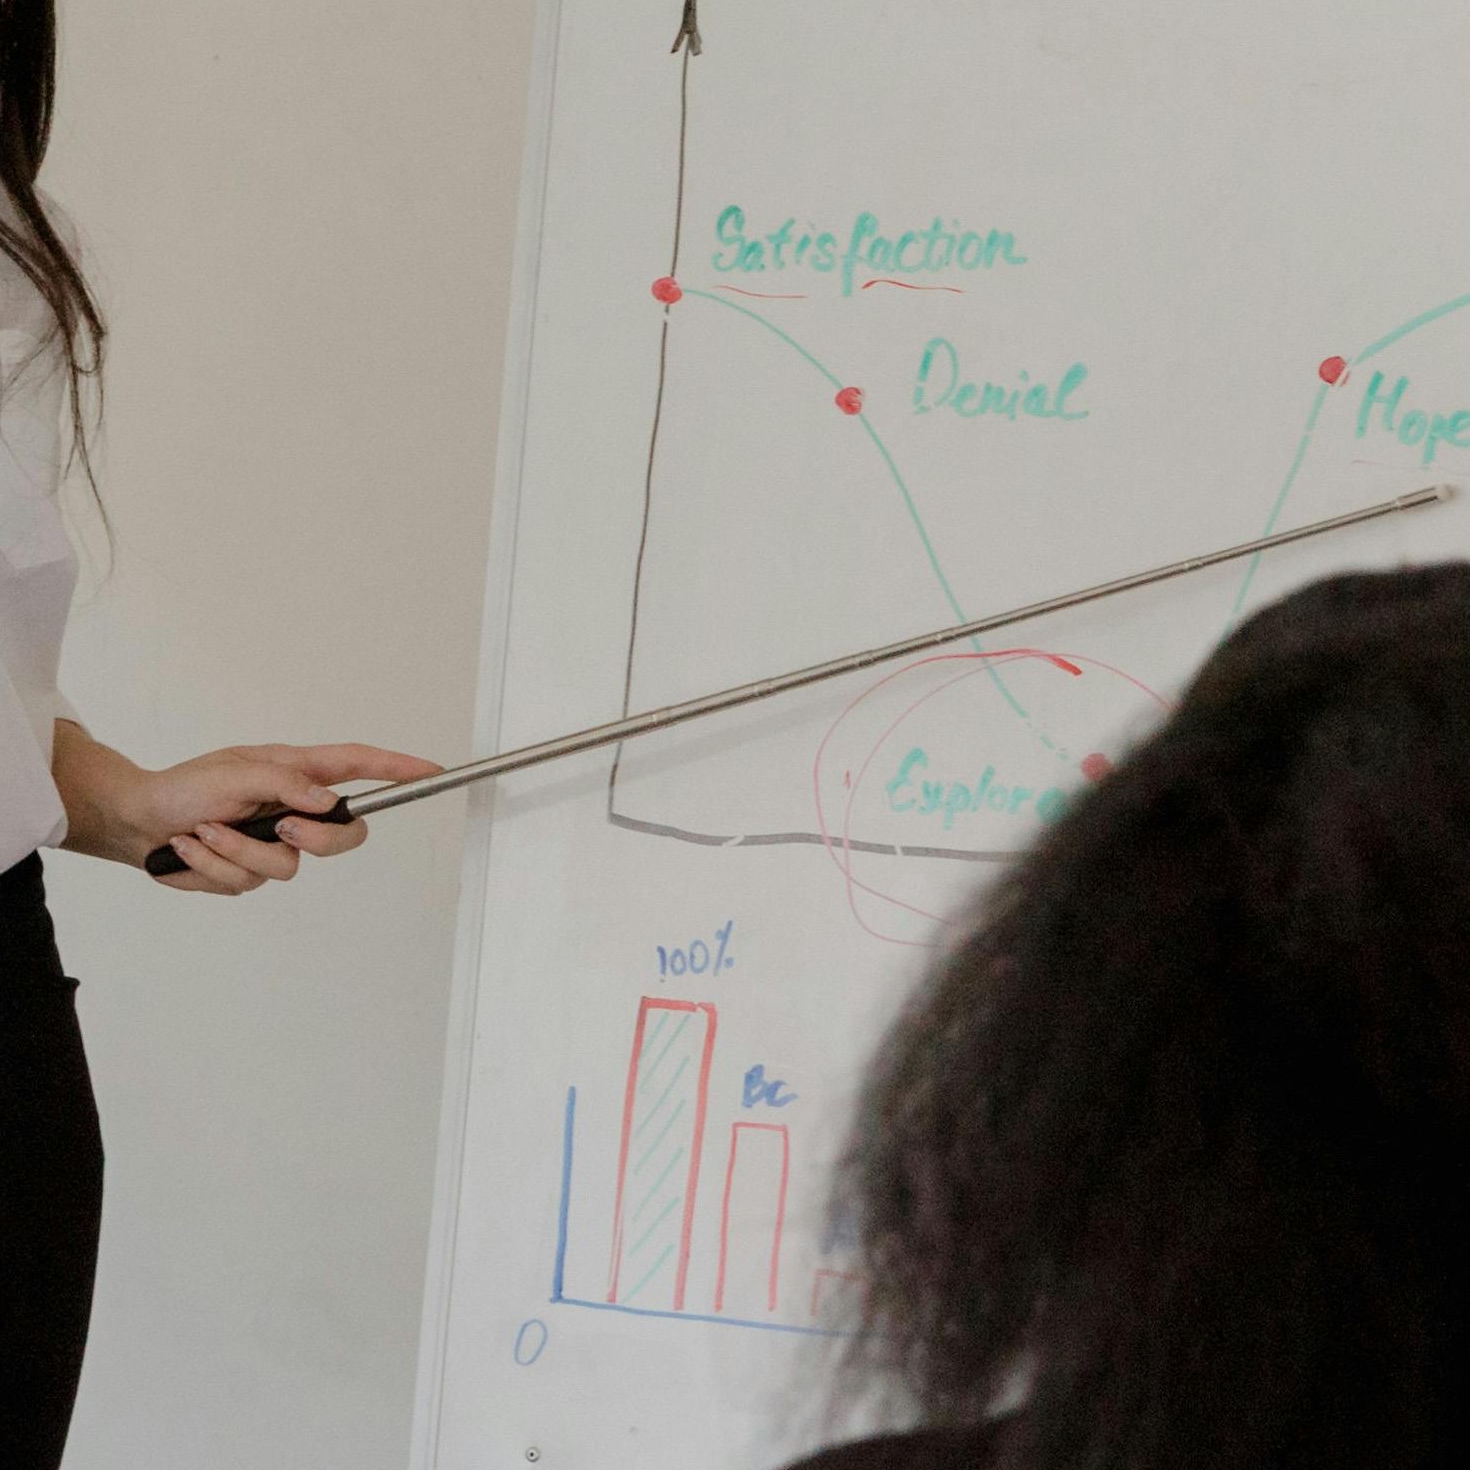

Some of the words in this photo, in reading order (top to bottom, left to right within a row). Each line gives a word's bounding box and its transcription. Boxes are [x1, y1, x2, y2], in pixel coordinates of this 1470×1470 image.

[712, 205, 1028, 297] Satisfaction
[913, 337, 1089, 420] Denial
[657, 920, 735, 977] 100%
